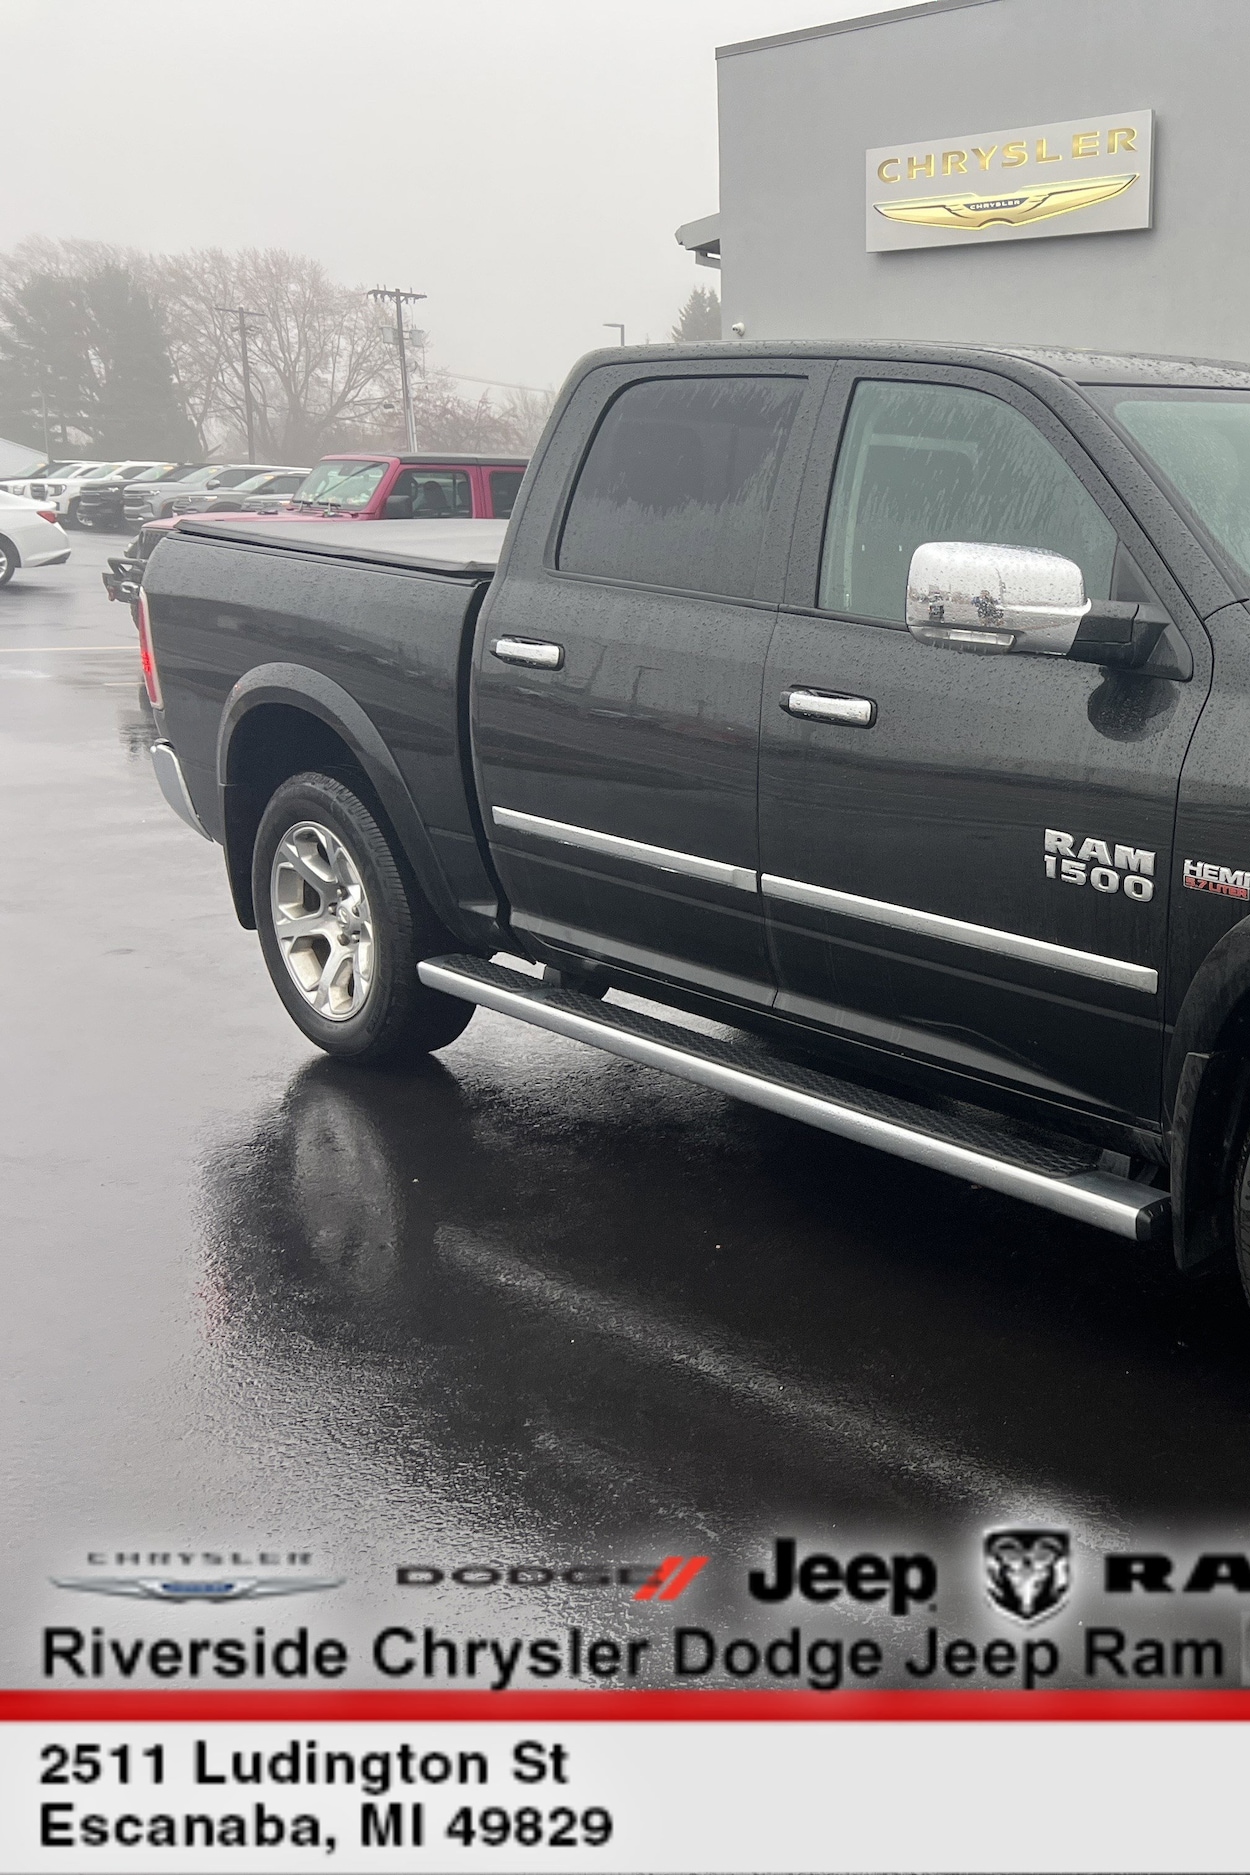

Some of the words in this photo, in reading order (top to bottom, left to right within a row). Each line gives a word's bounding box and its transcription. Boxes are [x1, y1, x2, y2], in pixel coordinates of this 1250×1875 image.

[877, 127, 1139, 184] CHRYSLER
[970, 200, 1021, 210] CHRYSLER
[1044, 828, 1156, 876] RAM
[1044, 855, 1154, 902] 1500
[1185, 876, 1208, 889] 5.7
[1209, 881, 1247, 899] LITER
